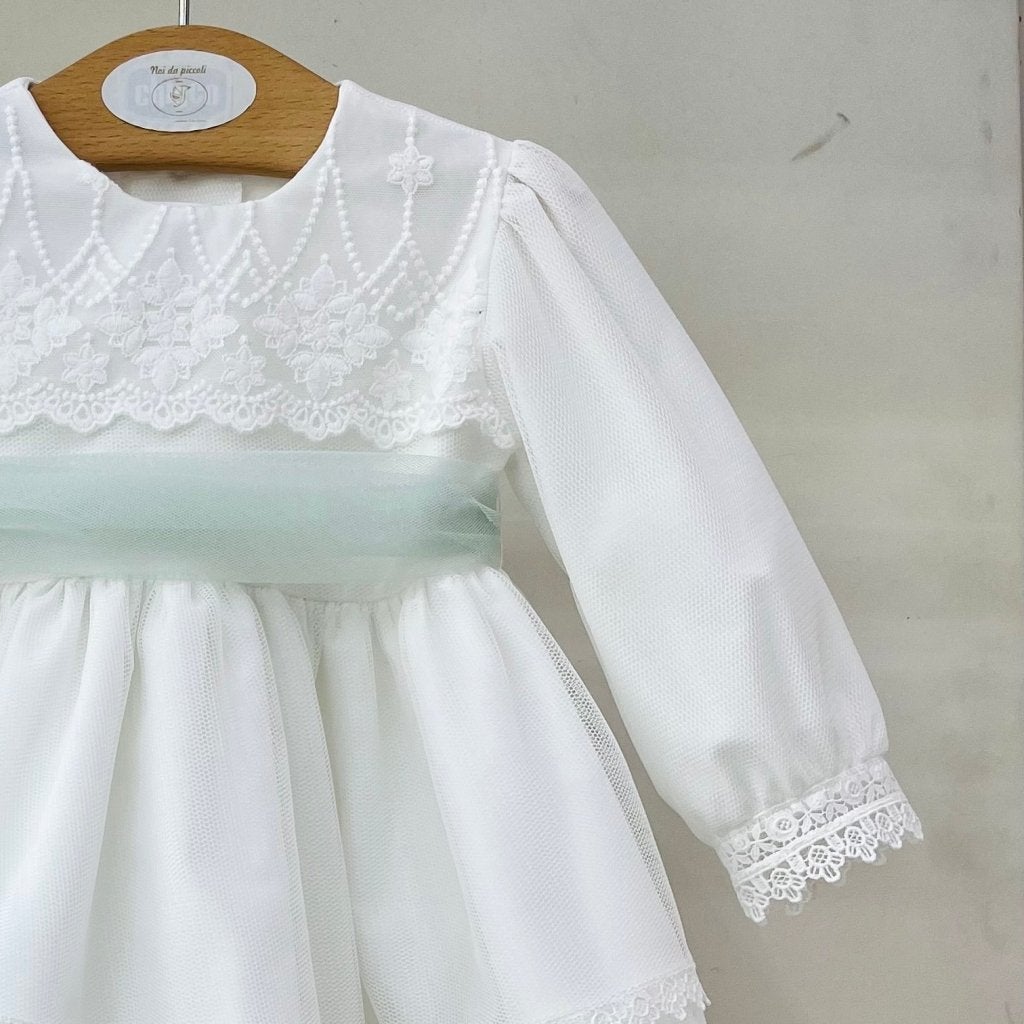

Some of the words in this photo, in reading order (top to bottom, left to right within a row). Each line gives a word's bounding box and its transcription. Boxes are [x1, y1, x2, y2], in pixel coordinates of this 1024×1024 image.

[150, 65, 166, 75] Noi
[167, 65, 178, 75] da
[179, 65, 207, 76] piccoli
